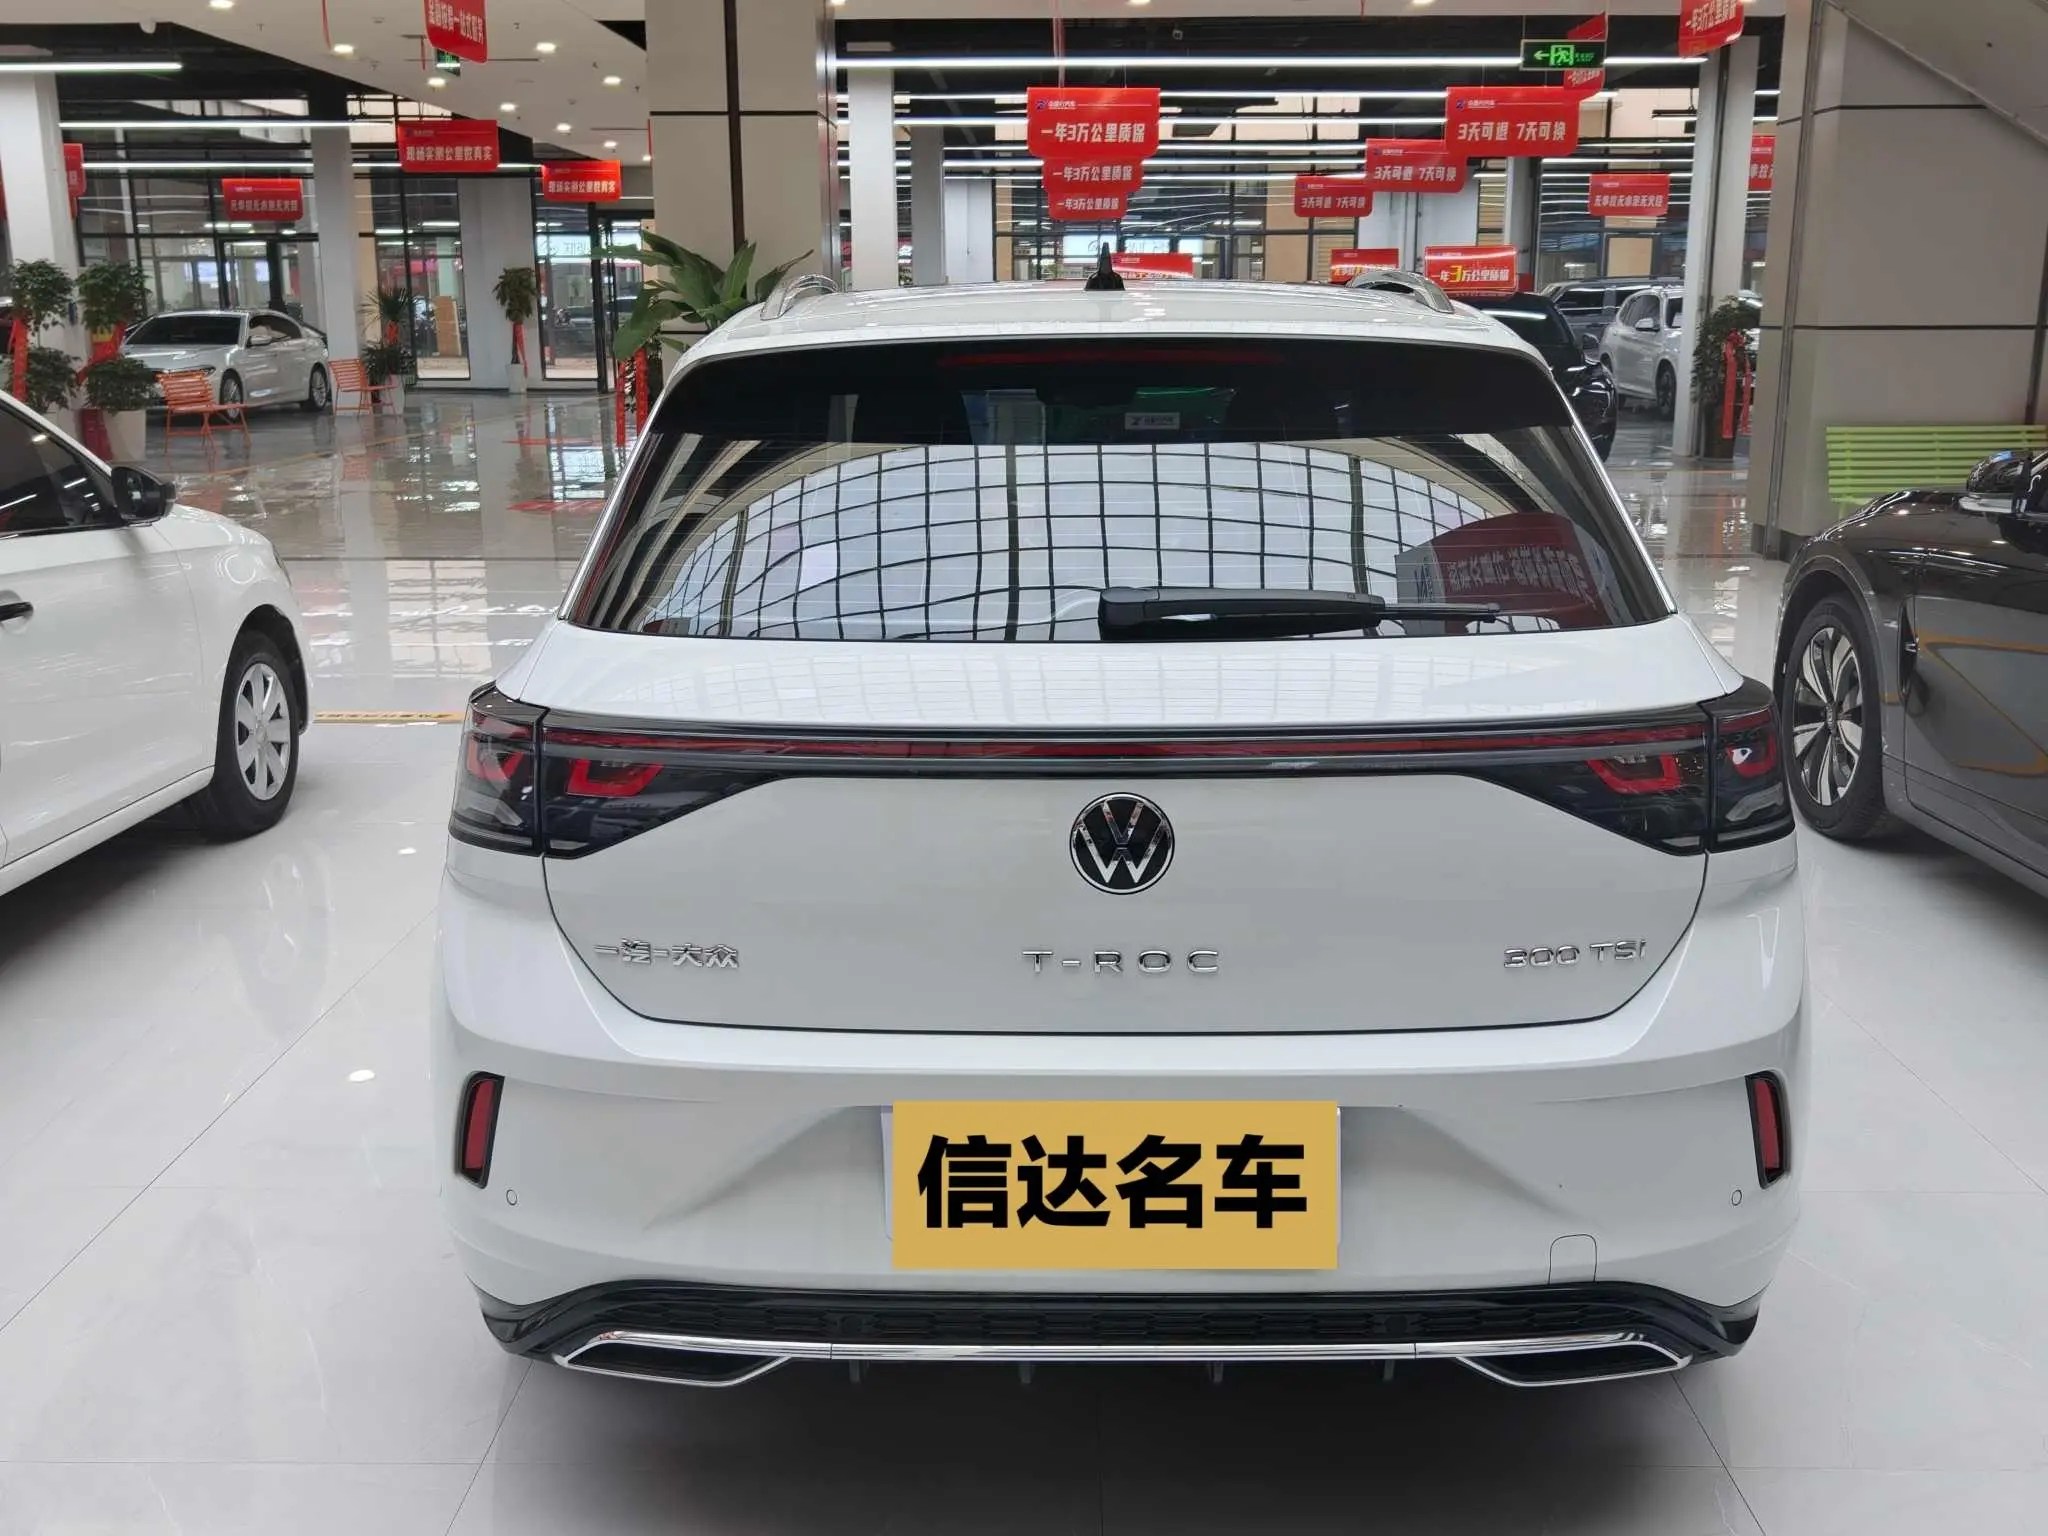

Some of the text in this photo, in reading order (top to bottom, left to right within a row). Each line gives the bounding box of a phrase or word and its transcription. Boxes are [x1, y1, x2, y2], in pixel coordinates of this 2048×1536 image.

[1041, 123, 1145, 142] 一年3万公里质保
[1457, 121, 1566, 141] 3天可退 7天可换
[1052, 166, 1132, 181] 一年3万公里质保
[1373, 166, 1457, 181] 3天可退 7天可换
[1057, 198, 1119, 210] 一年3万公里质保
[1022, 950, 1220, 974] T-ROC
[1504, 945, 1581, 968] 300
